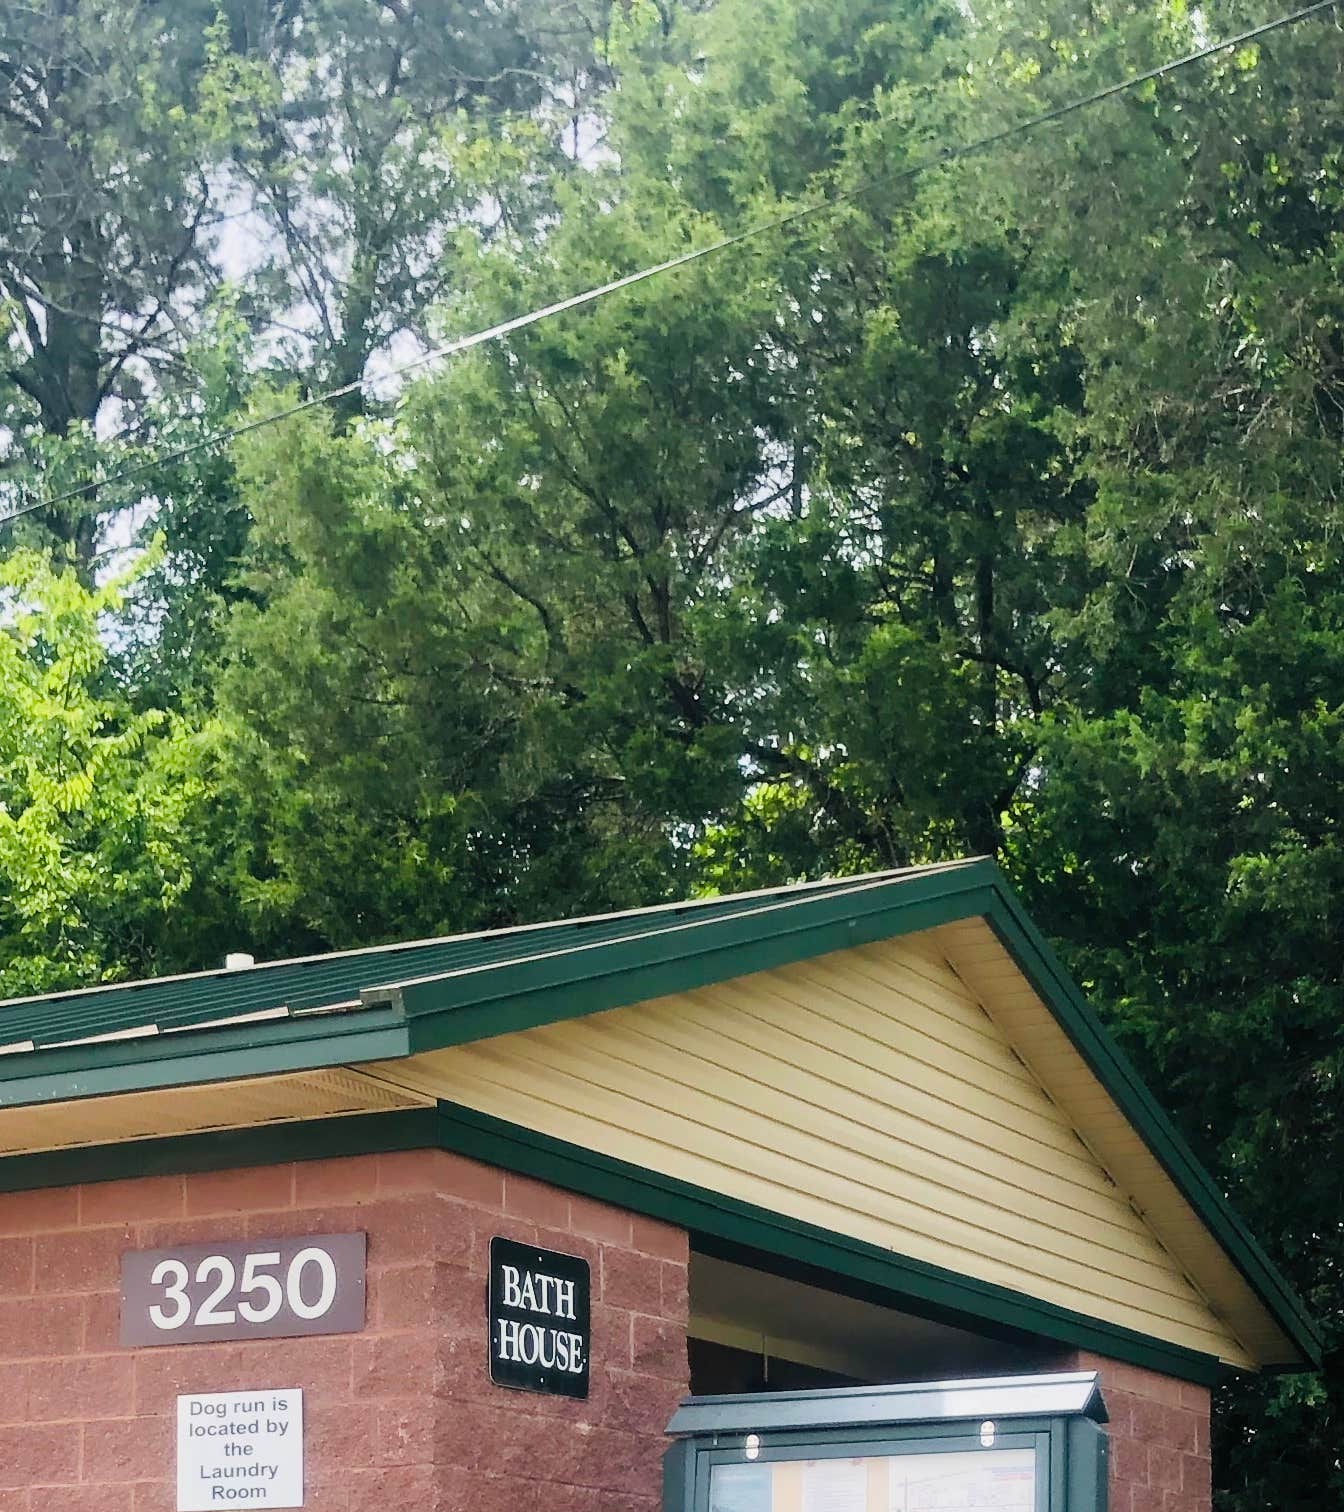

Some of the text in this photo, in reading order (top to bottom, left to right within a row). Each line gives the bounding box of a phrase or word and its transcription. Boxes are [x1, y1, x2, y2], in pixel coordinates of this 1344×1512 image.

[149, 1247, 337, 1329] 3250
[502, 1265, 575, 1320] BATH
[497, 1318, 583, 1374] HOUSE
[190, 1397, 288, 1417] Dog run is
[189, 1419, 289, 1437] located by
[224, 1442, 254, 1457] the
[200, 1463, 278, 1480] Laundry
[212, 1485, 267, 1500] Room
